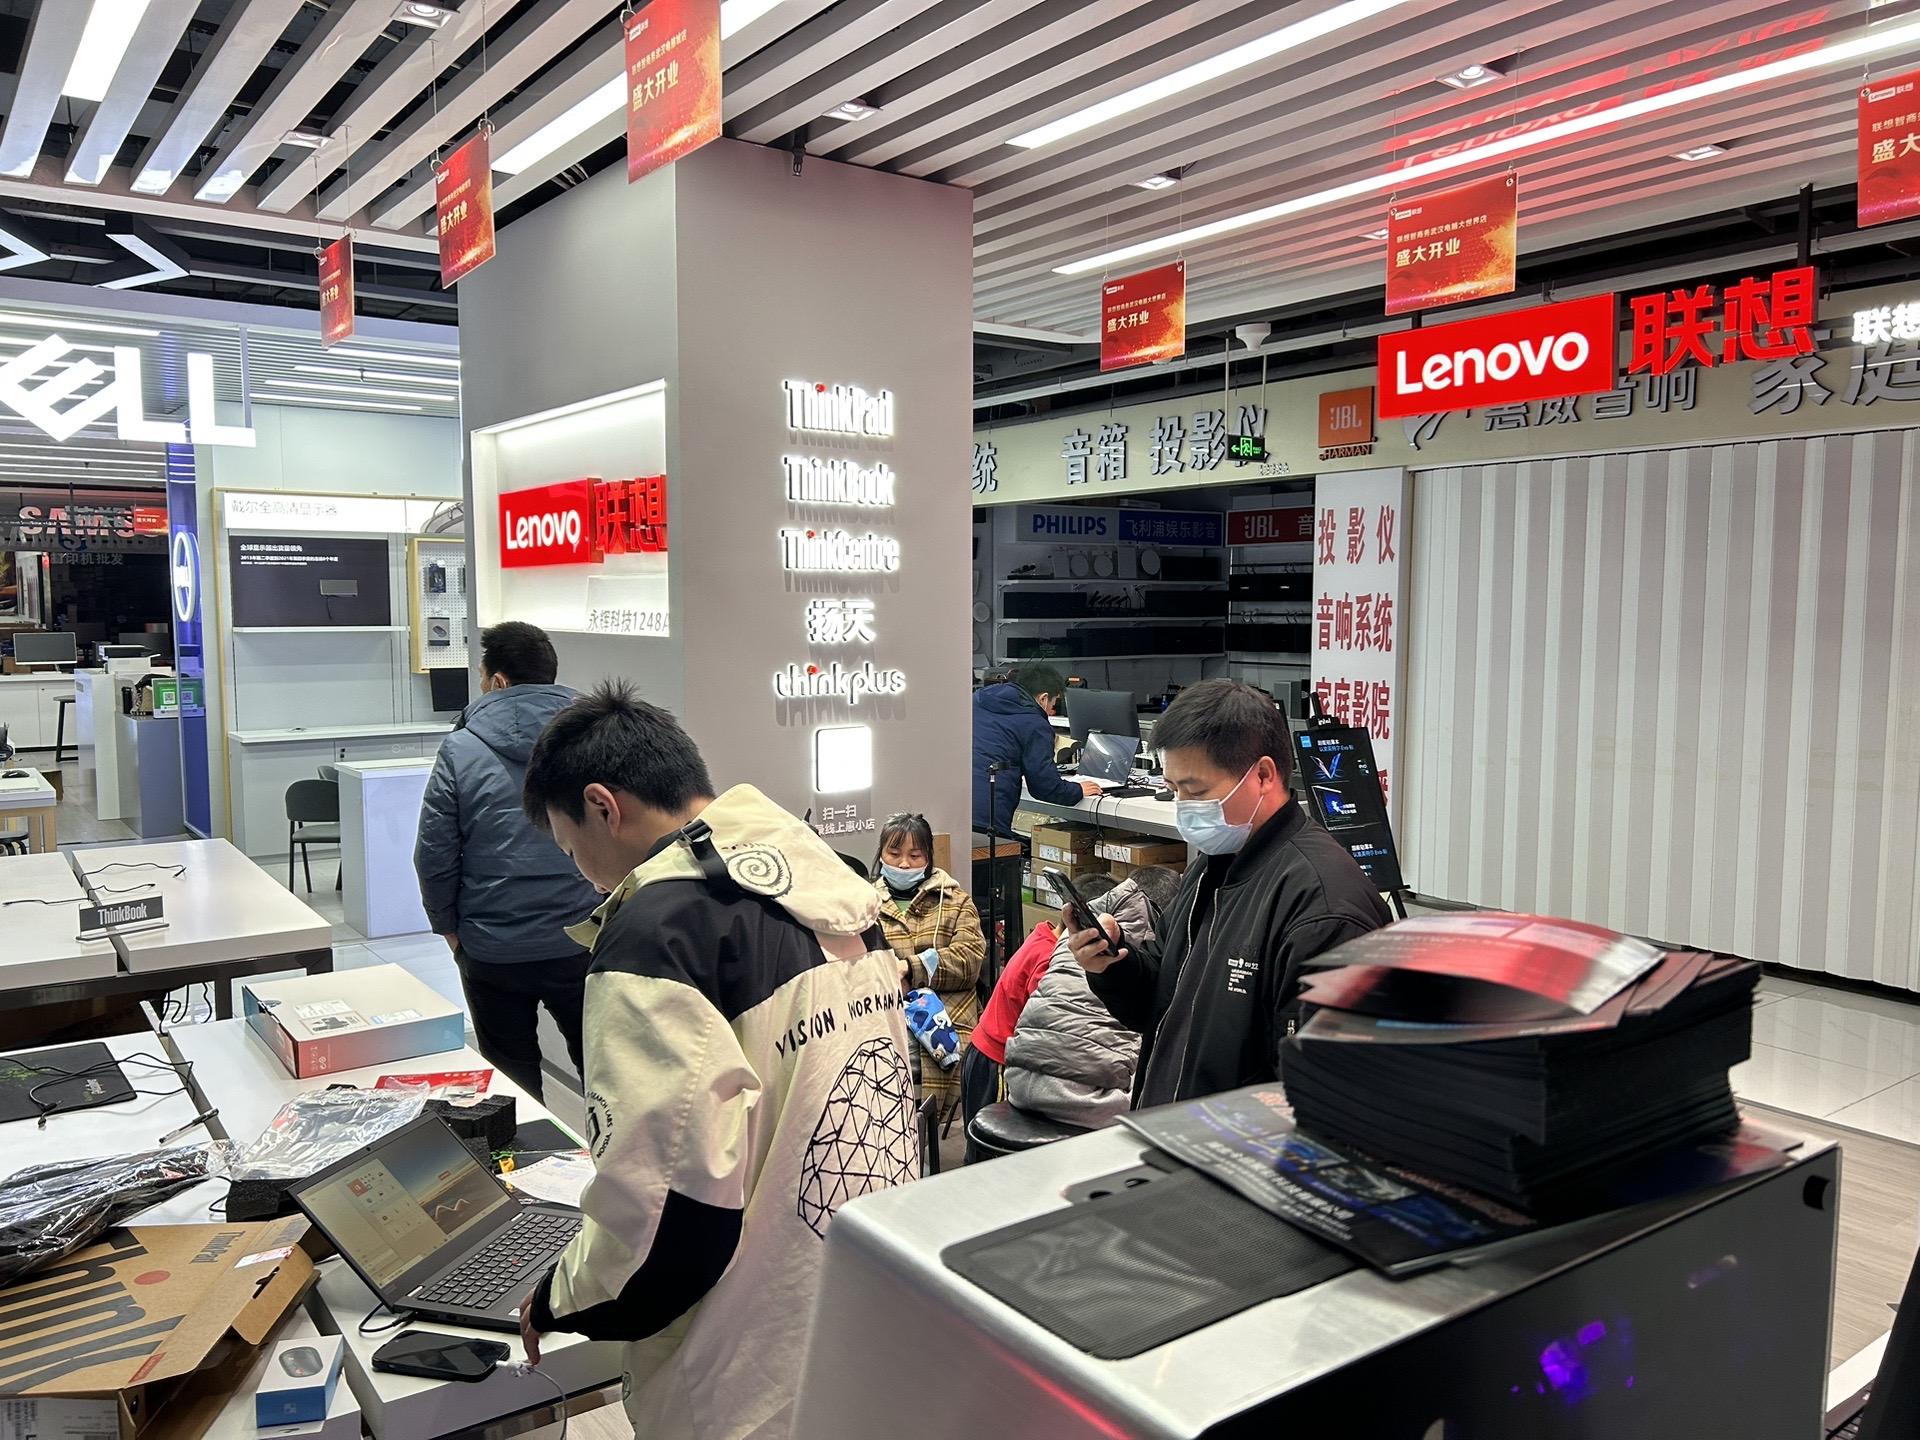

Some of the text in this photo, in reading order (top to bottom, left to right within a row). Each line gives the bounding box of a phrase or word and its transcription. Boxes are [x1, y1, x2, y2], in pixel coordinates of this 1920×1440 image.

[632, 59, 679, 112] 盛大开业
[1871, 111, 1920, 133] 联想智商
[1396, 237, 1460, 268] 盛大开业
[1107, 310, 1150, 333] 盛大开业
[1396, 266, 1819, 396] Lenovo 联想
[0, 334, 256, 447] ELL
[784, 380, 895, 436] ThinkPad
[1329, 405, 1363, 431] JBL
[1060, 421, 1128, 486] 音箱
[1324, 444, 1373, 460] HARMAN
[784, 457, 896, 506] ThinkBook
[505, 473, 668, 555] Lenovo 联想
[1032, 512, 1218, 539] PHILIPS 飞利浦娱乐影音
[1243, 513, 1314, 539] JBL 音
[1318, 504, 1396, 566] 投影仪
[781, 529, 901, 573] ThinkCentre
[806, 599, 878, 644] 扬天
[1316, 591, 1394, 652] 音响系统
[775, 663, 906, 705] thinkplus
[822, 804, 857, 821] 扫一扫
[97, 903, 148, 925] ThinkBook
